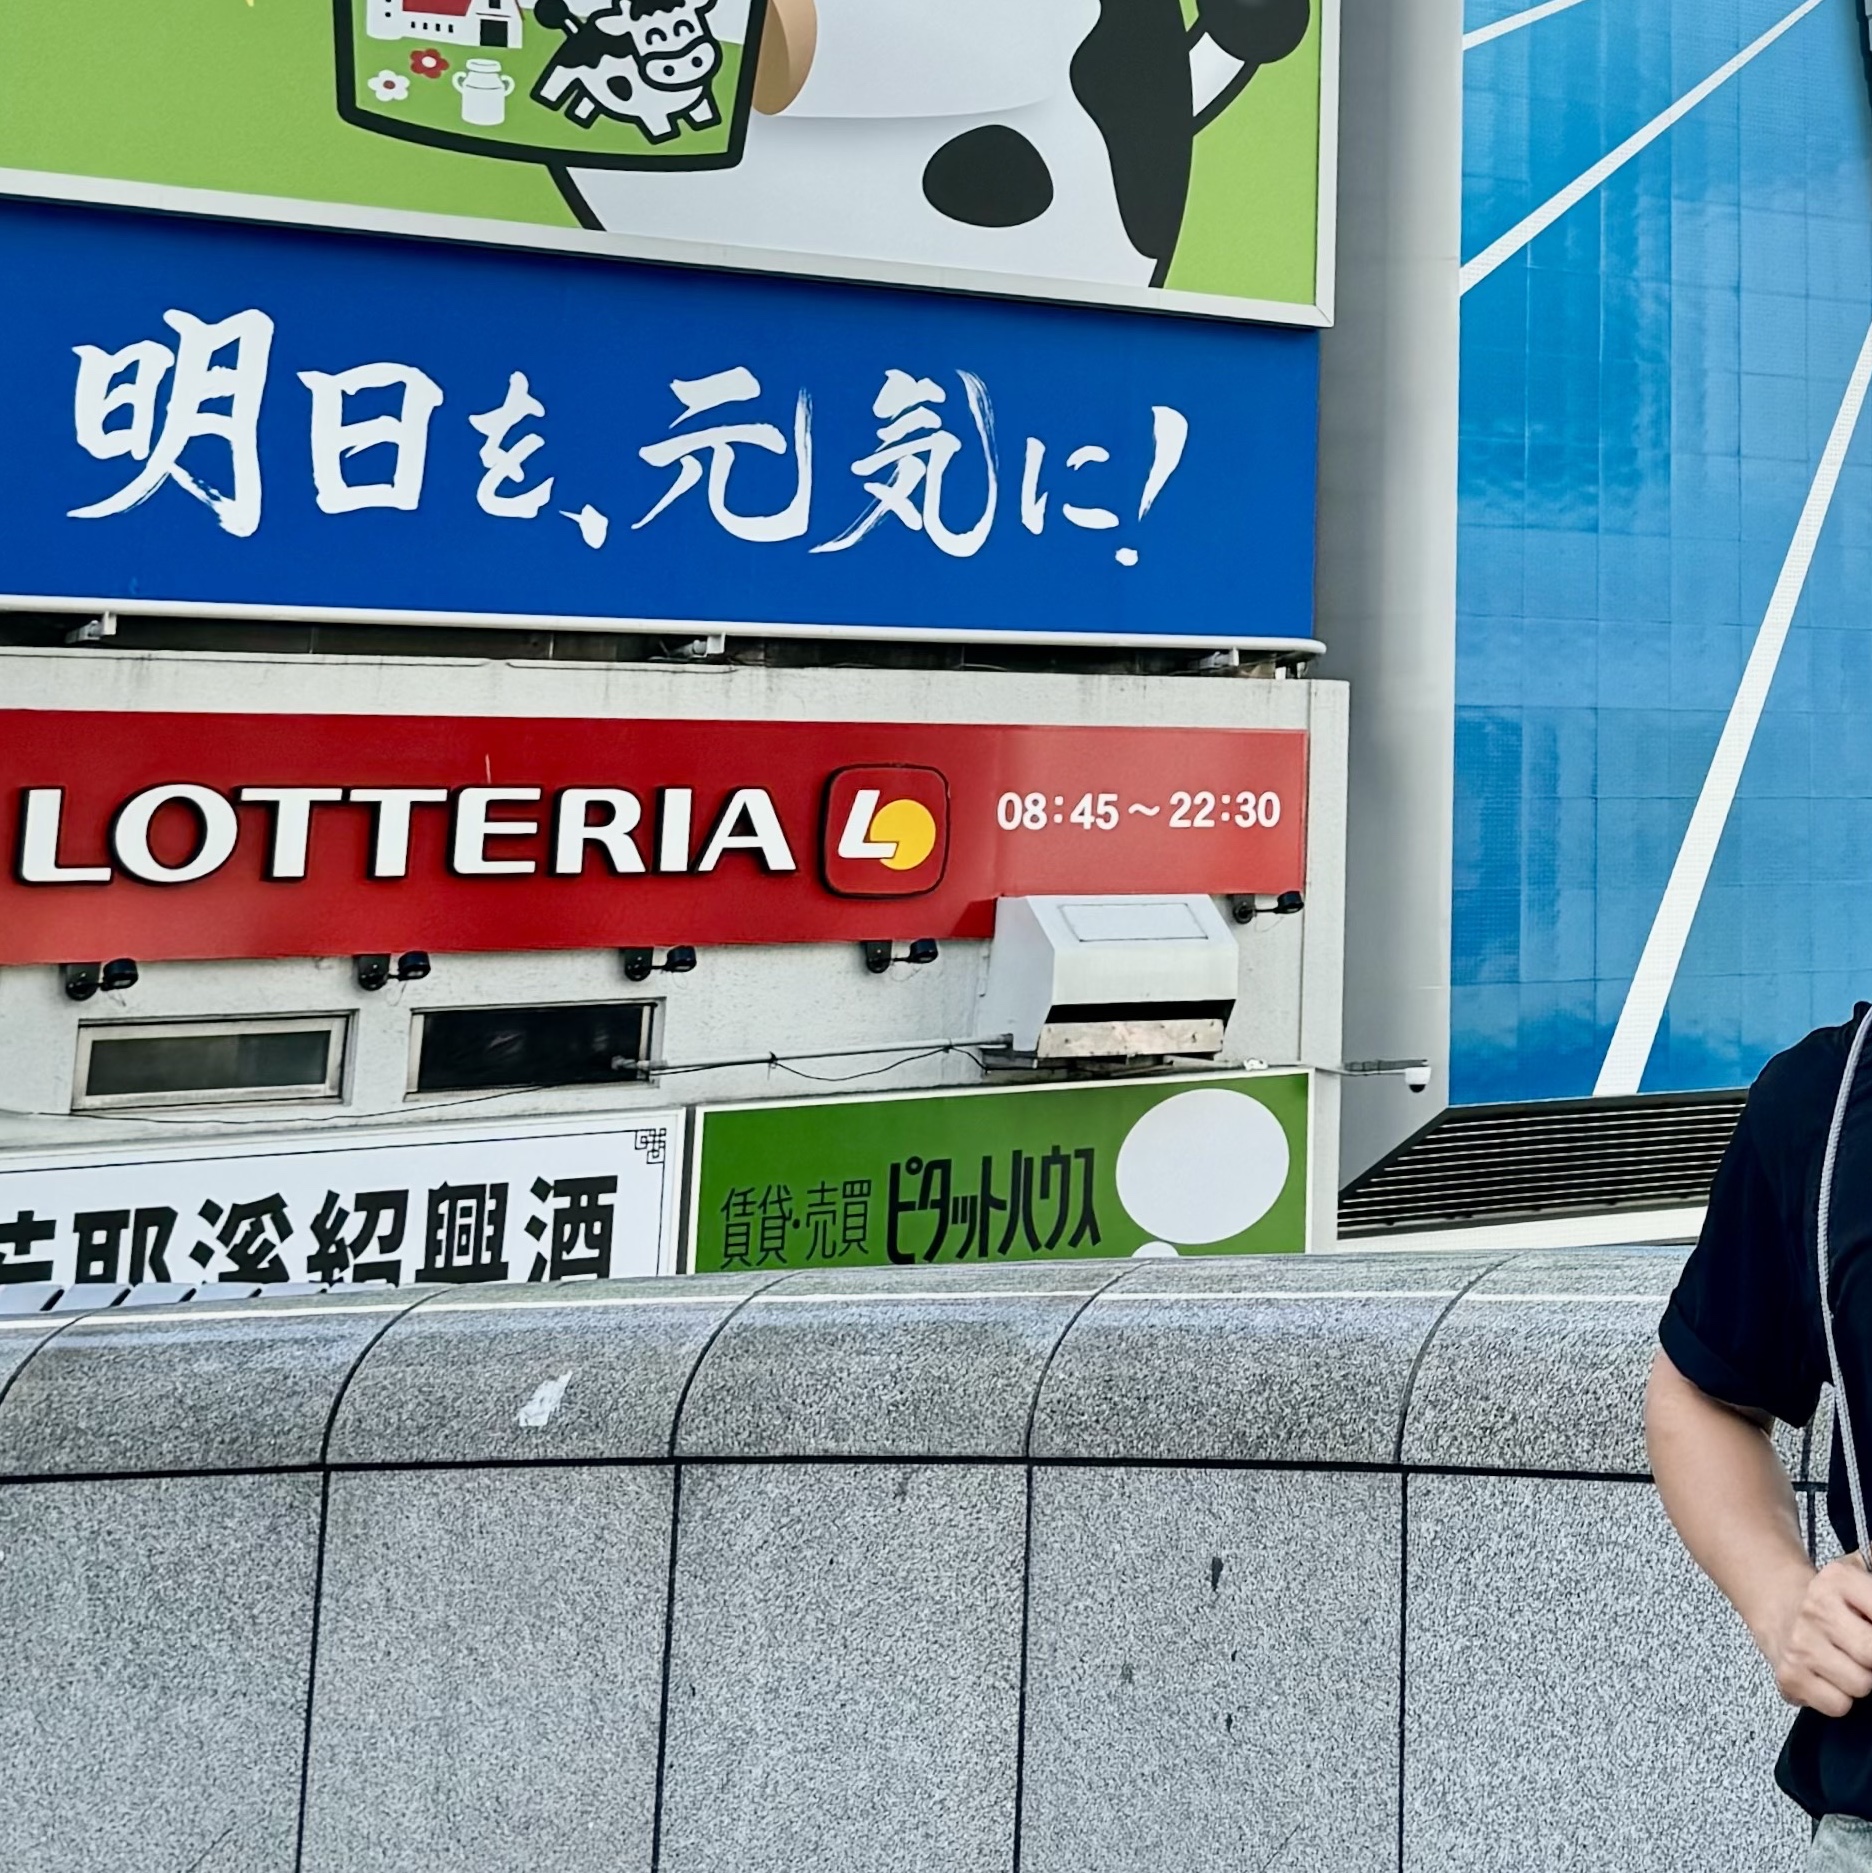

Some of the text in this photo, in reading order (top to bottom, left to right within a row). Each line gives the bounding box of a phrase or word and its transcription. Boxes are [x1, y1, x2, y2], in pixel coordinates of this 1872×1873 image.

[22, 783, 797, 883] LOTTERIA
[886, 1144, 1102, 1266] ピタットハウス
